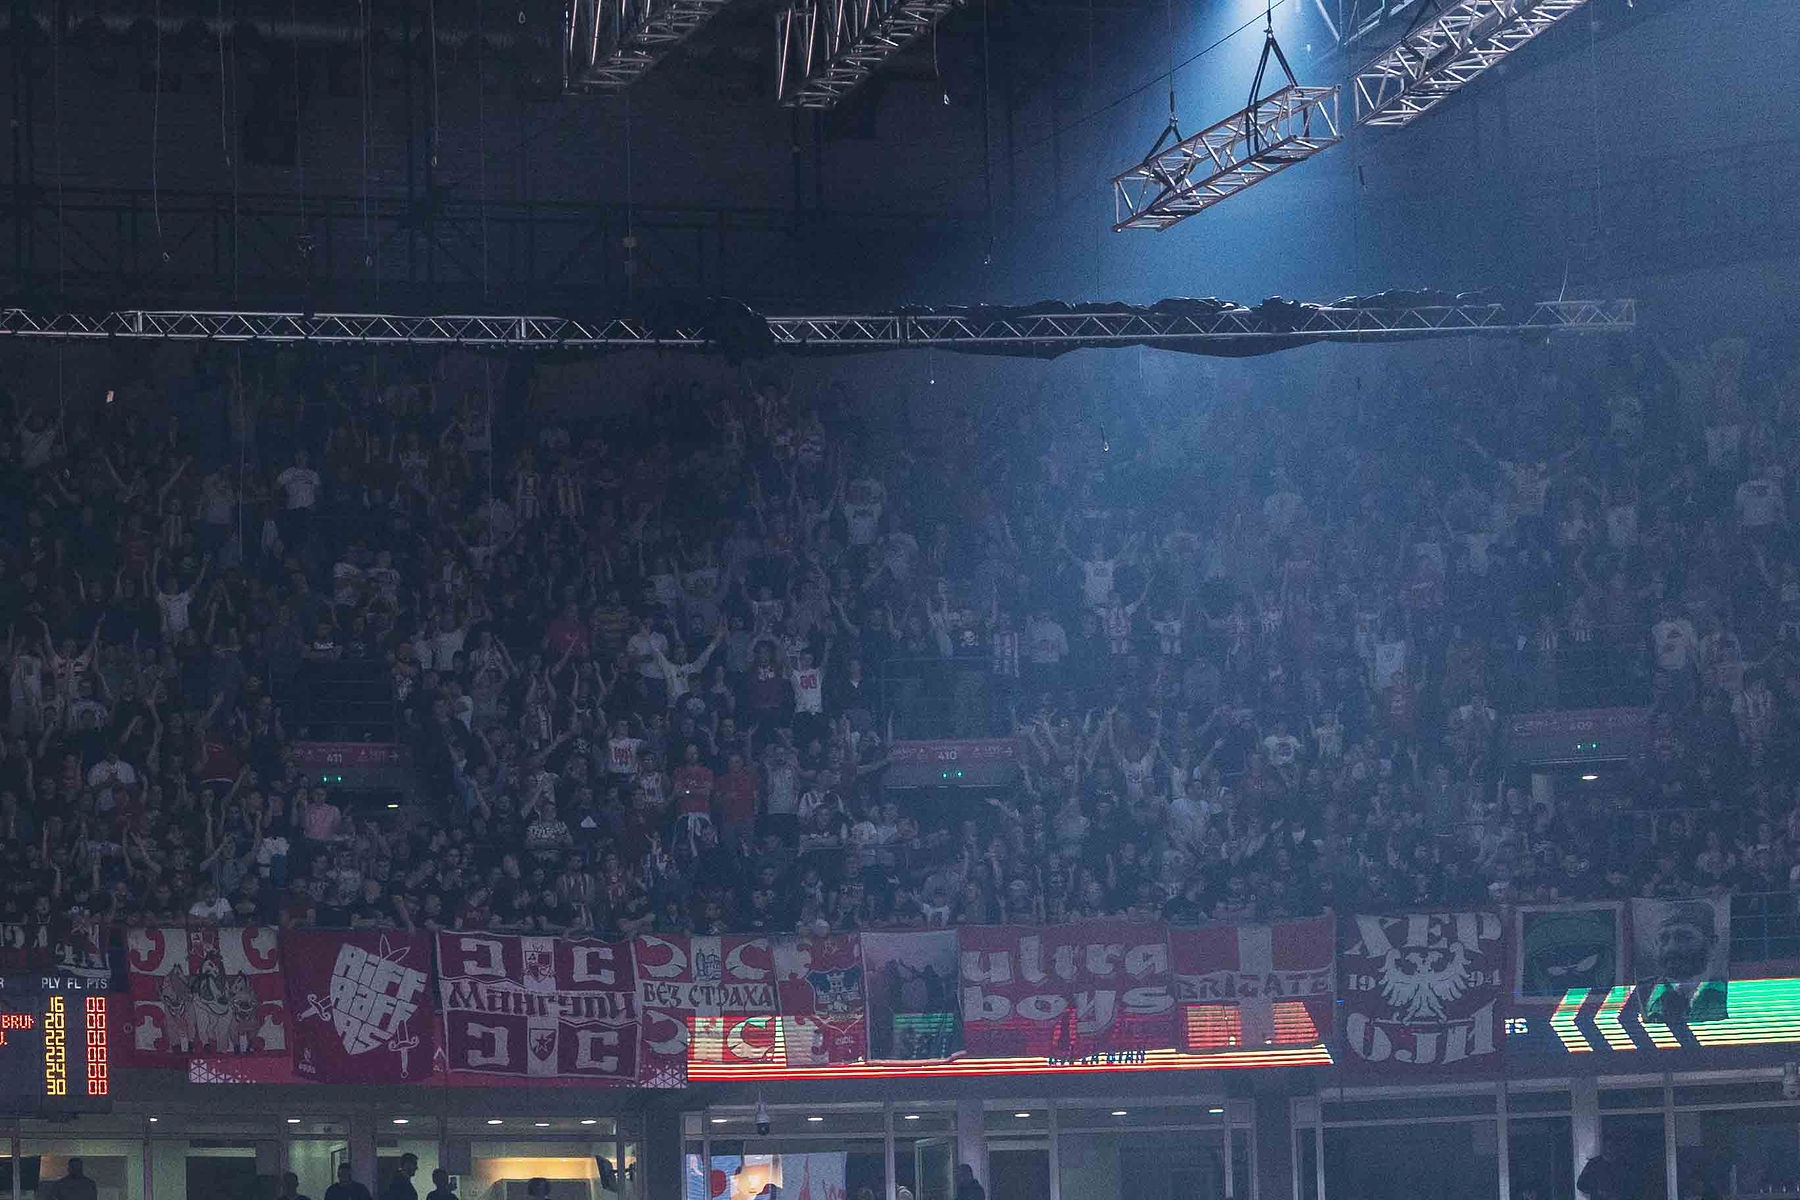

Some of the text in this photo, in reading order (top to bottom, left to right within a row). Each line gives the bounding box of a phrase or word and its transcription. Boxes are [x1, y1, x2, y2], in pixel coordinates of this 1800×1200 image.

[86, 977, 108, 990] PTS
[50, 995, 65, 1013] 16
[44, 1012, 65, 1029] 20
[45, 1029, 65, 1046] 22
[45, 1045, 66, 1063] 23
[45, 1062, 66, 1079] 24
[46, 1078, 67, 1096] 30
